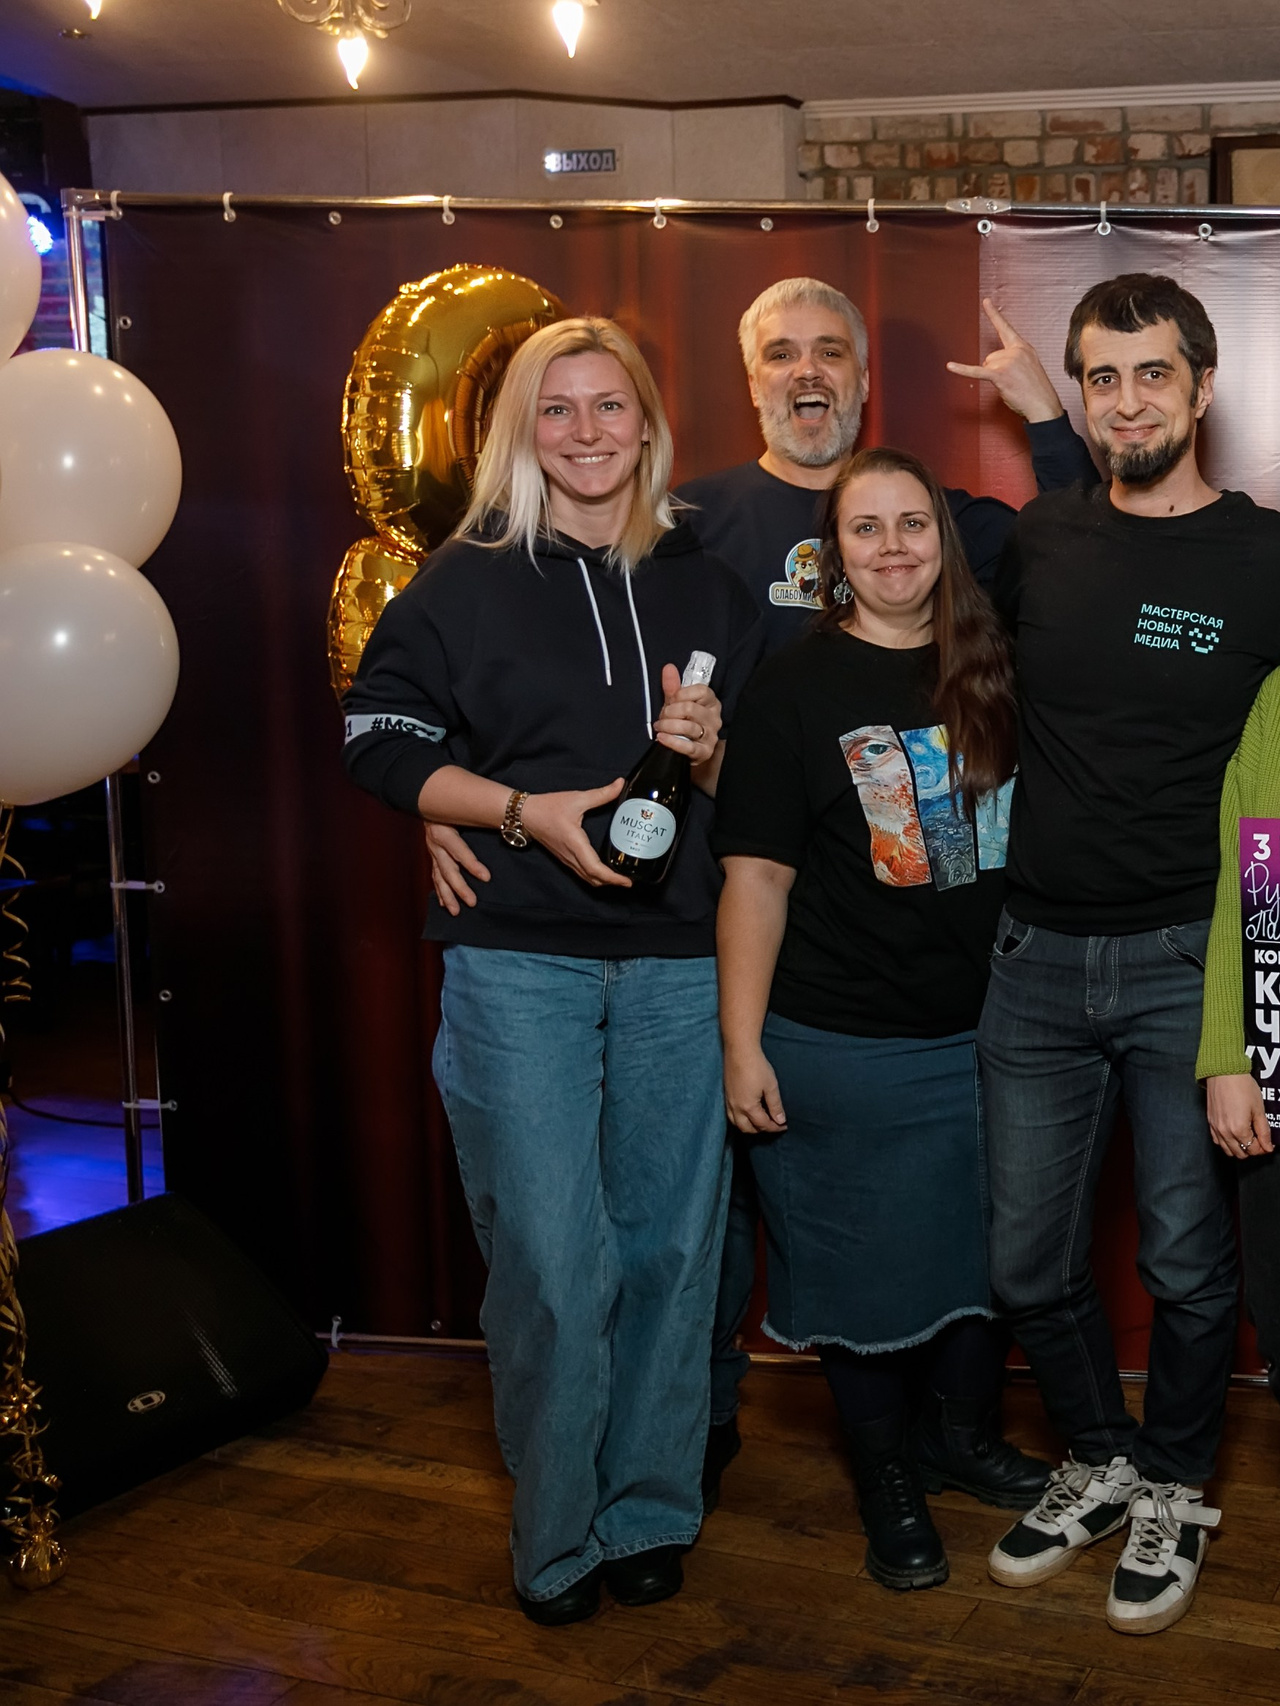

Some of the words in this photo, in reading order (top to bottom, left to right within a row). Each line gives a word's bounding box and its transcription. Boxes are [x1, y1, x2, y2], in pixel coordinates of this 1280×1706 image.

[547, 152, 614, 173] ВЫХОД
[1141, 603, 1224, 630] МАСТЕРСКАЯ
[1137, 618, 1183, 635] НОВЫХ
[1134, 633, 1180, 650] МЕДИА
[620, 816, 667, 837] MUSCAT
[626, 829, 653, 843] ITALY
[1253, 833, 1271, 861] 3
[1265, 1113, 1276, 1121] ИЗ,
